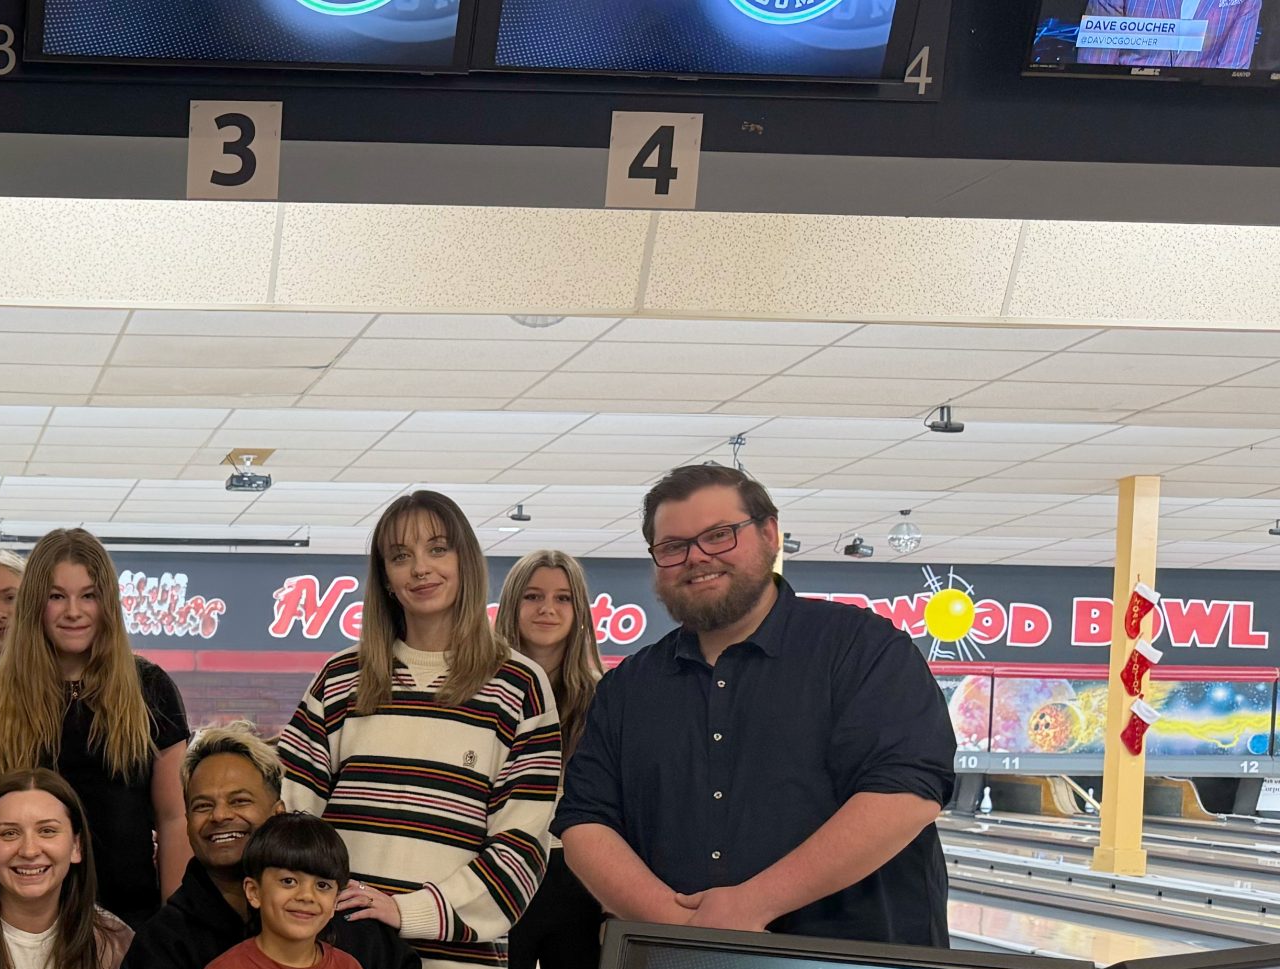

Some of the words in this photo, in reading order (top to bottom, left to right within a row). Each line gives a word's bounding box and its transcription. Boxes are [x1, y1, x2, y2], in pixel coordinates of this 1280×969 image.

[1085, 20, 1117, 31] DAVE
[1119, 21, 1176, 33] GOUCHER
[1081, 36, 1158, 46] @DAVIDCGOUCHER
[903, 46, 933, 95] 4
[209, 112, 257, 187] 3
[627, 125, 678, 195] 4
[1071, 597, 1269, 649] BWL
[958, 755, 978, 769] 10
[1001, 756, 1020, 770] 11
[1240, 760, 1259, 774] 12
